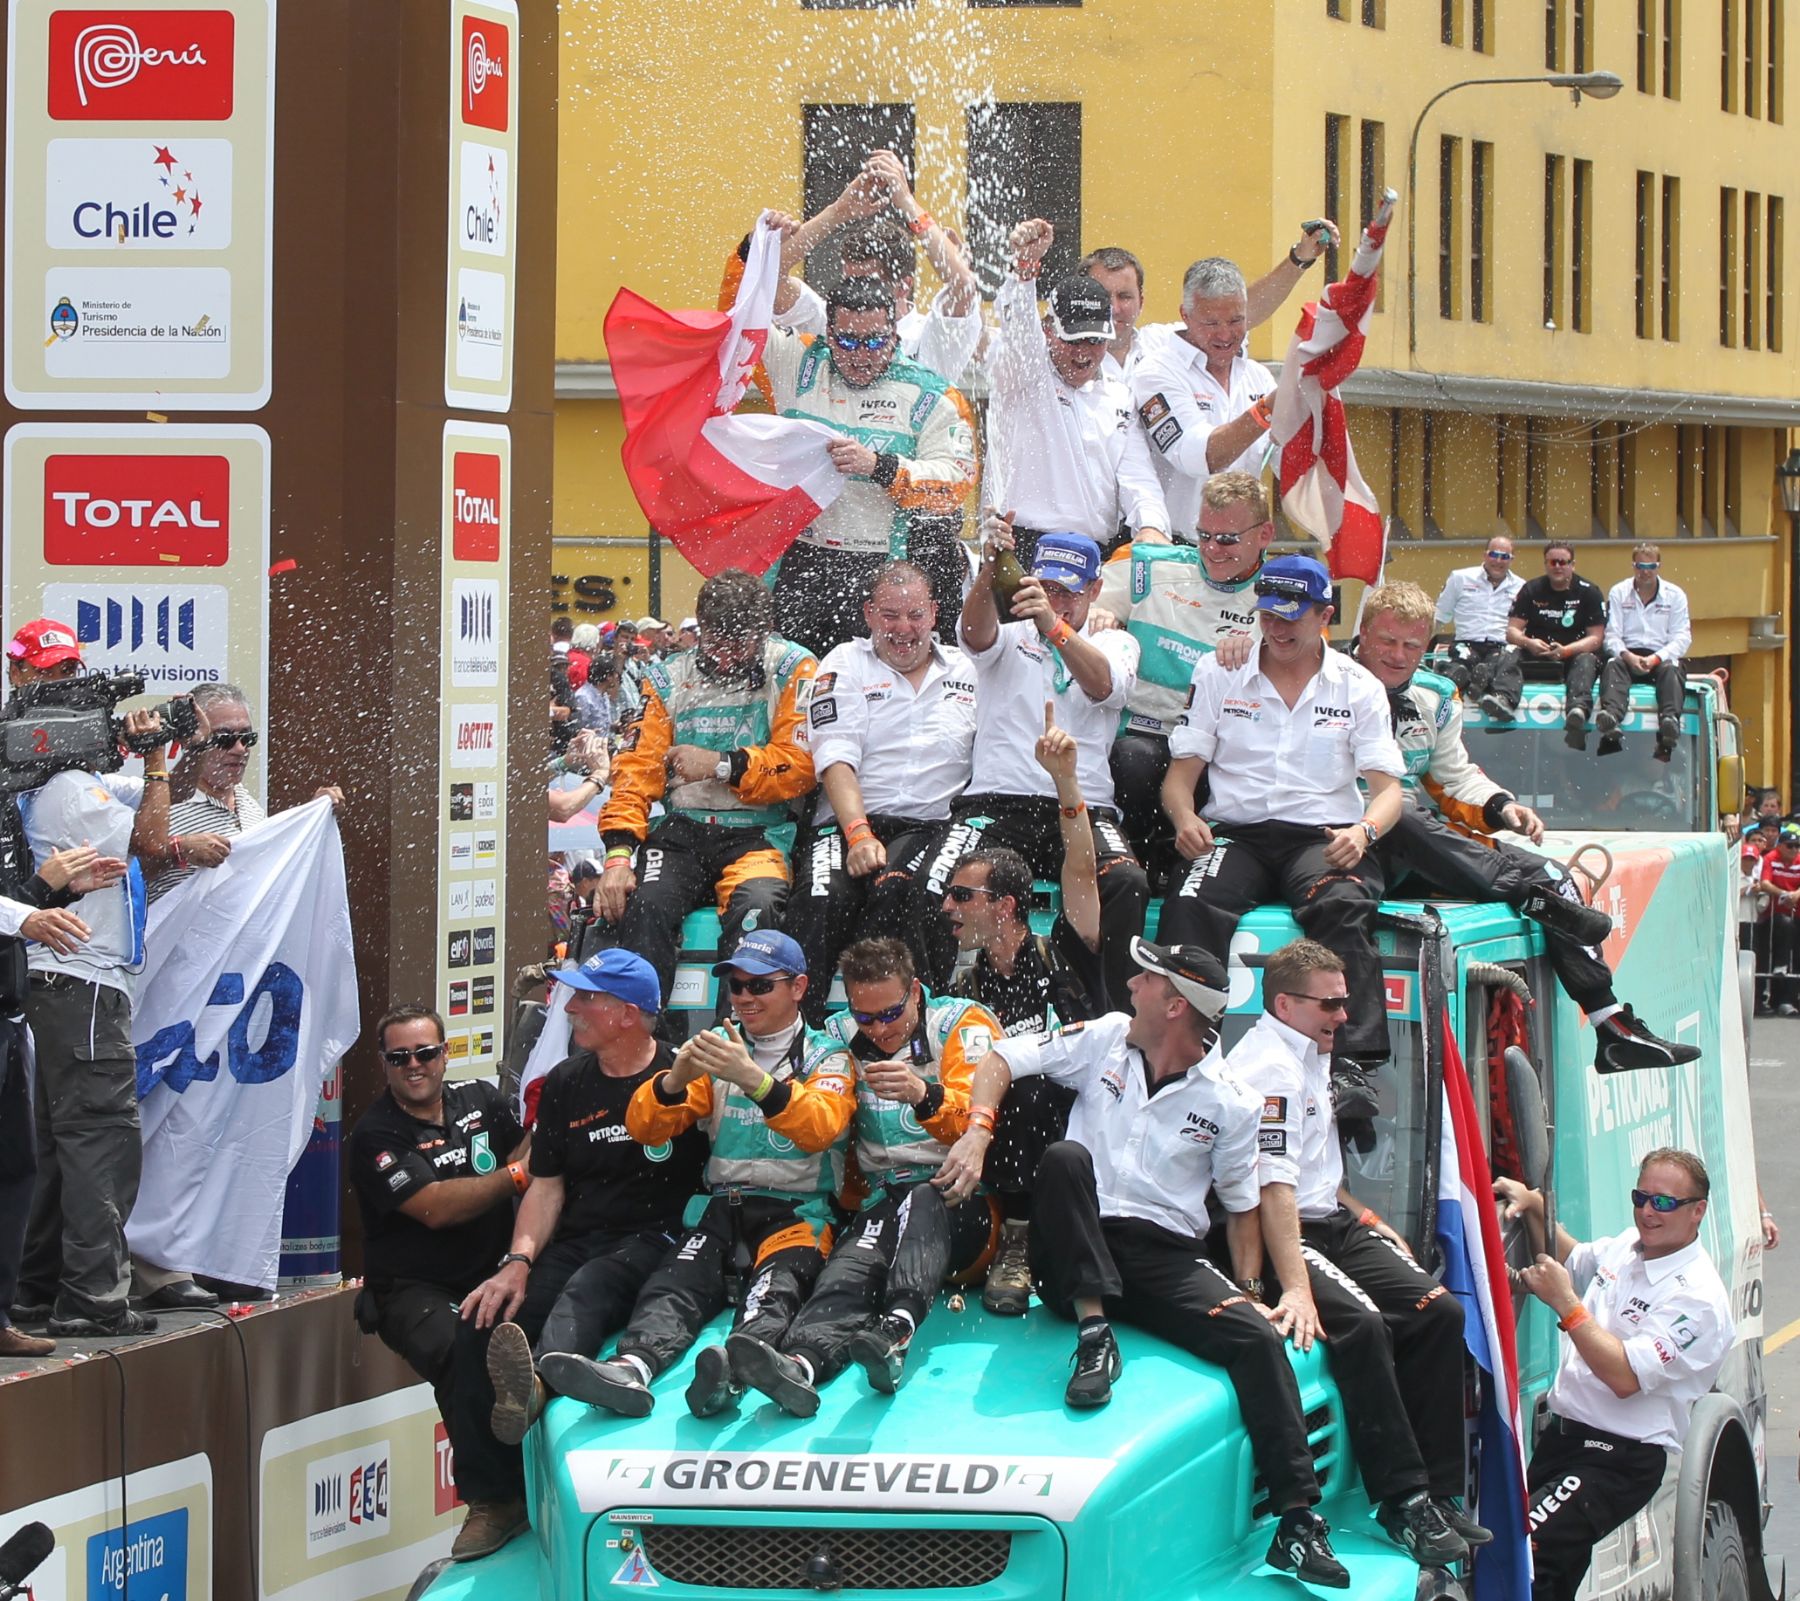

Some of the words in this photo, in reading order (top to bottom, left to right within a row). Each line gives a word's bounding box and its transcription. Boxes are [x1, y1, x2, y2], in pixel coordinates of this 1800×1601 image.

[74, 24, 206, 107] Perú
[73, 202, 178, 238] Chile
[466, 205, 494, 243] Chile
[82, 301, 121, 310] Ministerio
[122, 301, 132, 310] de
[82, 312, 118, 321] Turismo
[82, 324, 148, 337] Presidencia
[150, 325, 167, 337] de
[169, 325, 179, 337] la
[182, 323, 221, 338] Nación
[53, 491, 220, 528] TOTAL
[454, 488, 499, 524] TOTAL
[1043, 550, 1084, 564] MICHELIN
[1135, 561, 1144, 594] sparco
[1220, 610, 1255, 625] IVECO
[942, 680, 974, 692] IVECO
[1314, 706, 1351, 718] IVECO
[32, 729, 50, 753] 2
[457, 721, 494, 750] LOCTITE
[926, 822, 972, 896] PETRONAS
[673, 980, 699, 991] .com
[1187, 1111, 1220, 1135] IVECO
[309, 1237, 326, 1252] body
[1583, 1439, 1614, 1452] sparco
[662, 1458, 999, 1495] GROENEVELD
[351, 1481, 362, 1519] 2
[366, 1479, 375, 1514] 3
[378, 1472, 387, 1511] 4
[1528, 1474, 1582, 1531] IVECO
[610, 1513, 653, 1521] MAINSWITCH
[101, 1533, 164, 1591] Argentina
